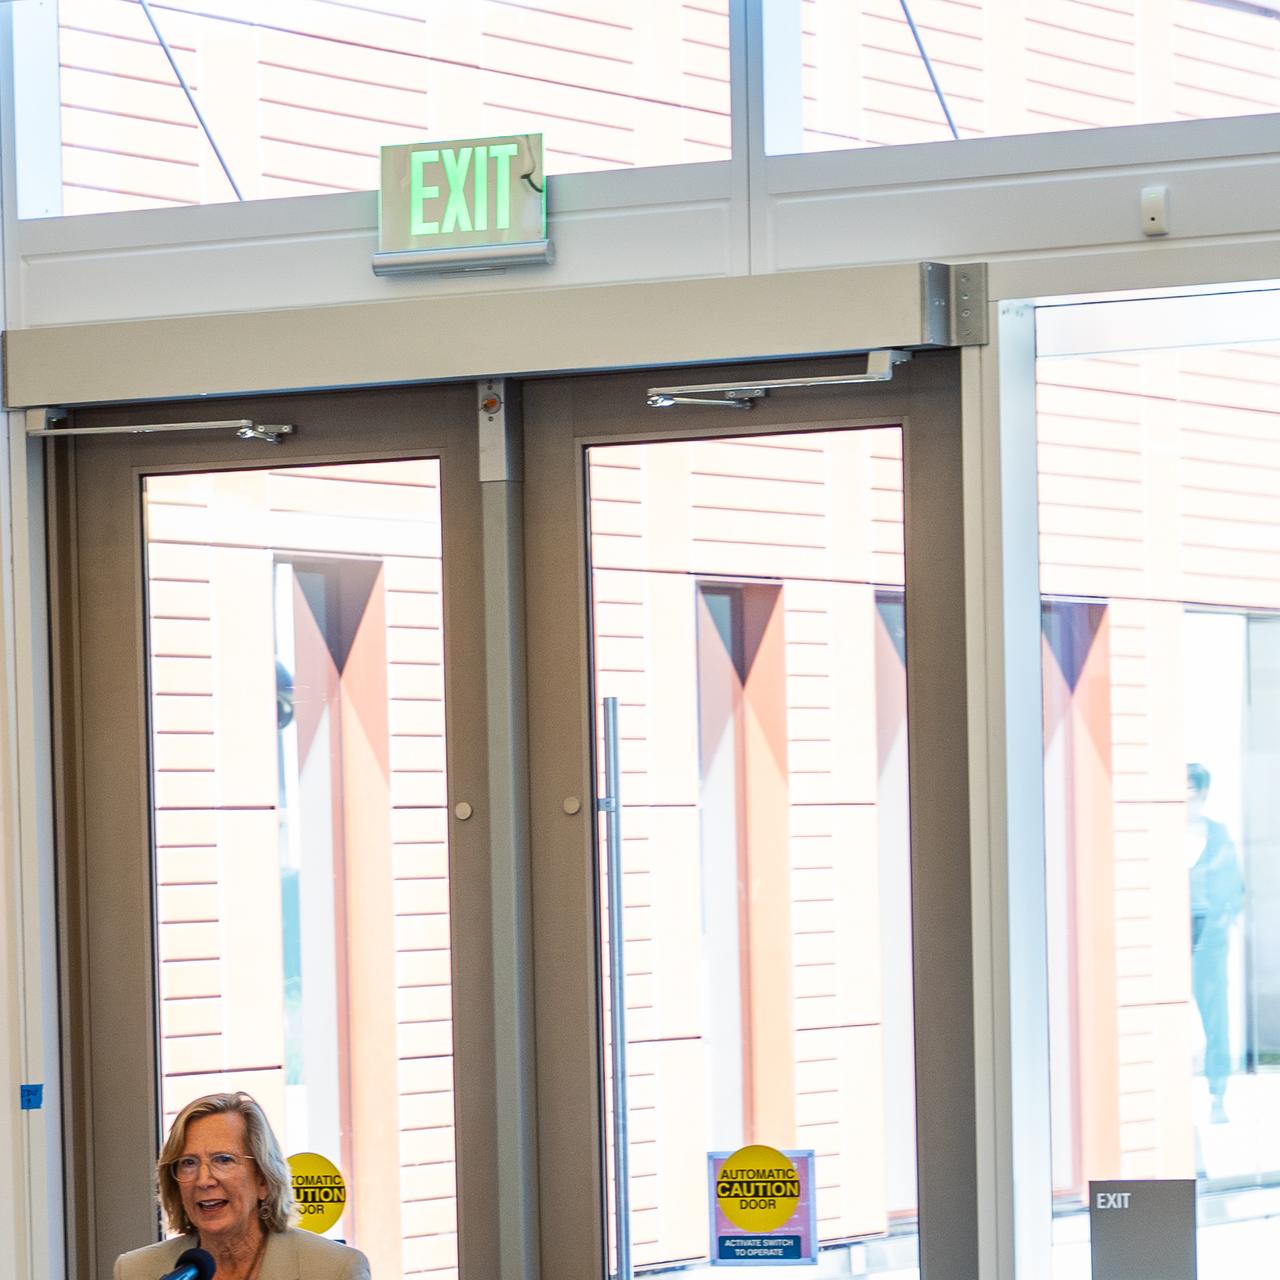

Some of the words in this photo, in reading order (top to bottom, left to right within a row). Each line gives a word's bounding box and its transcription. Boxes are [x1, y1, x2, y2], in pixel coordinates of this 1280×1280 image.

[410, 143, 518, 236] EXIT
[720, 1168, 796, 1180] AUTOMATIC
[291, 1175, 342, 1186] TOMATIC
[294, 1188, 345, 1202] UTION
[717, 1182, 800, 1197] CAUTION
[740, 1199, 777, 1210] DOOR
[1096, 1193, 1132, 1209] EXIT
[298, 1204, 325, 1215] OOR
[724, 1239, 762, 1247] ACTIVATE
[763, 1239, 794, 1247] SWITCH
[735, 1248, 747, 1256] TO
[747, 1248, 784, 1257] OPERATE
